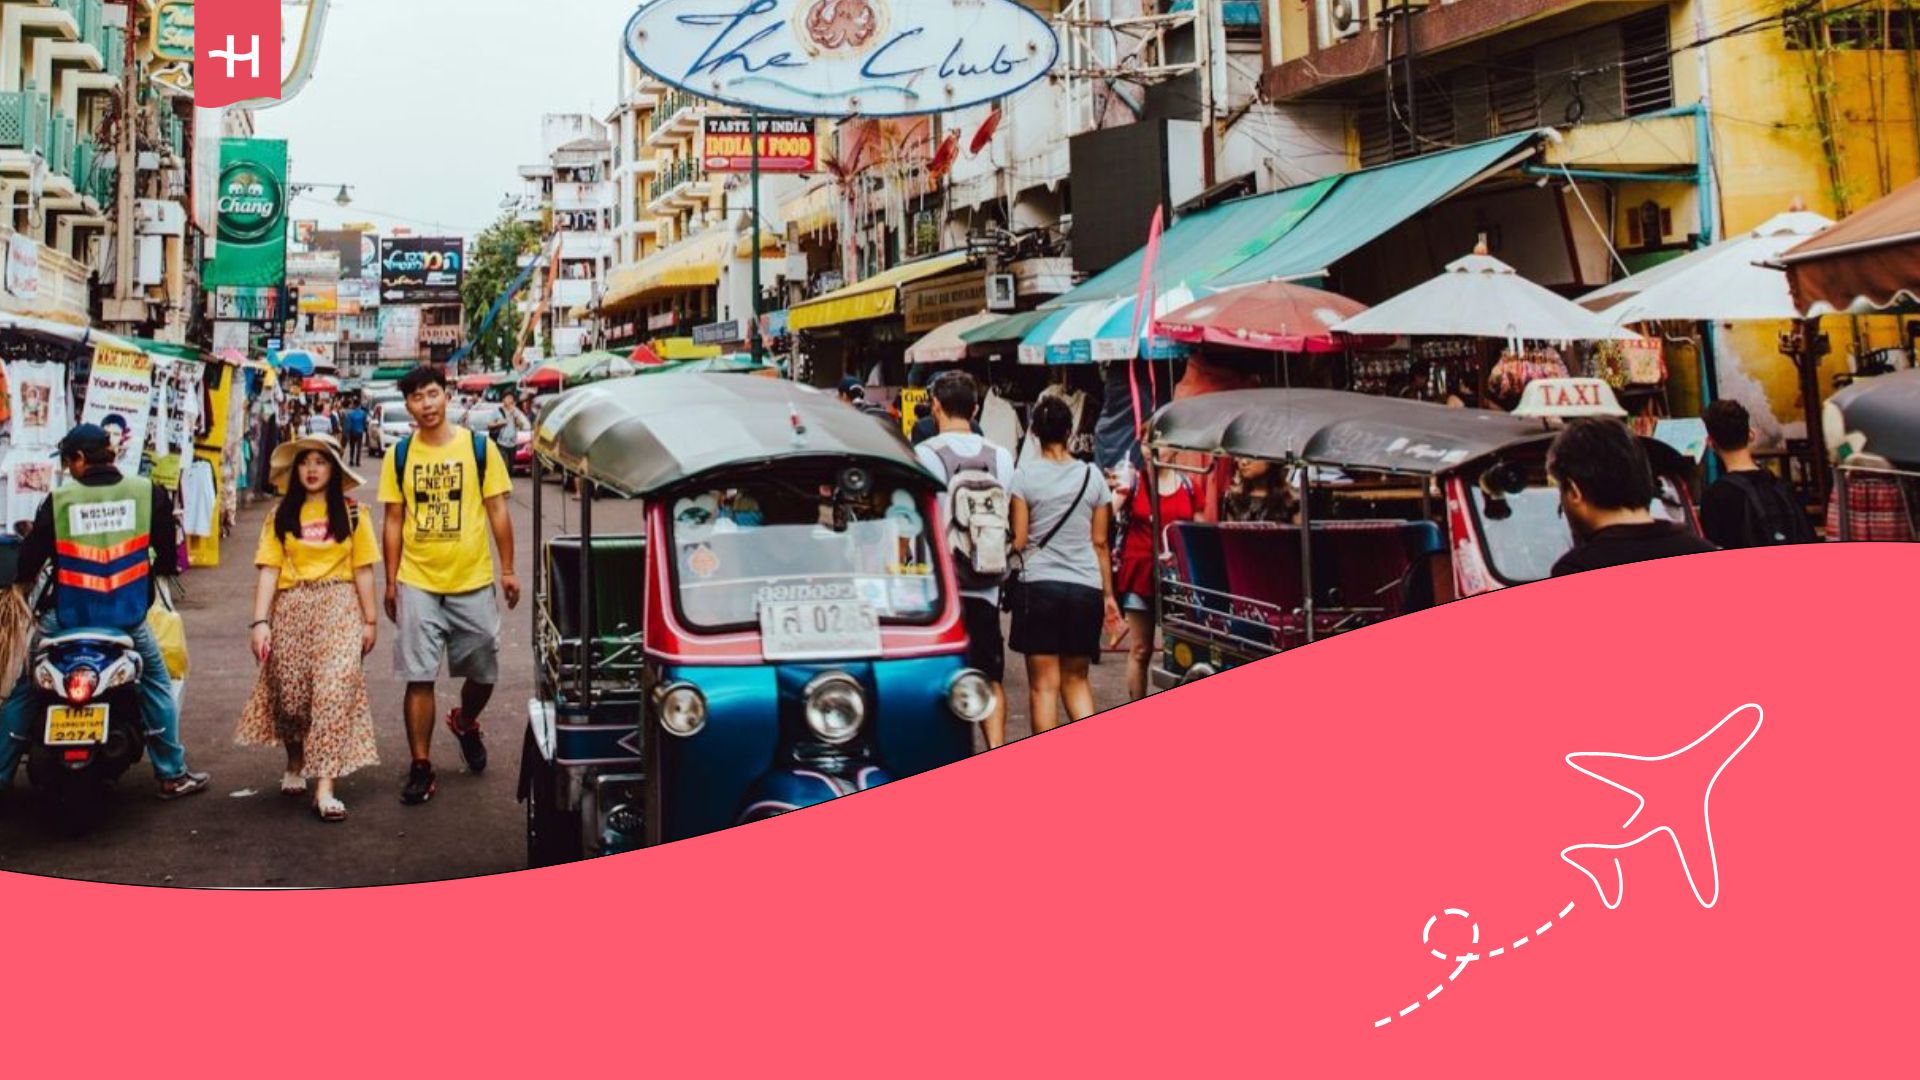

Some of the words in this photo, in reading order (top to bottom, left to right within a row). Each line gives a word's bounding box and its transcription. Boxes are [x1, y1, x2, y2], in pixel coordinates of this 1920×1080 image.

[676, 0, 807, 79] The
[860, 27, 1028, 80] Club
[709, 121, 750, 133] TASTE
[770, 121, 809, 133] INDIA
[706, 136, 766, 157] INDIAN
[768, 137, 812, 157] FOOD
[218, 196, 274, 217] Chang
[420, 328, 457, 338] INDIAN
[93, 376, 117, 389] Your
[118, 380, 150, 394] Photo
[1539, 383, 1601, 406] TAXI
[433, 462, 451, 476] AM
[418, 476, 441, 490] ONE
[442, 475, 457, 489] OF
